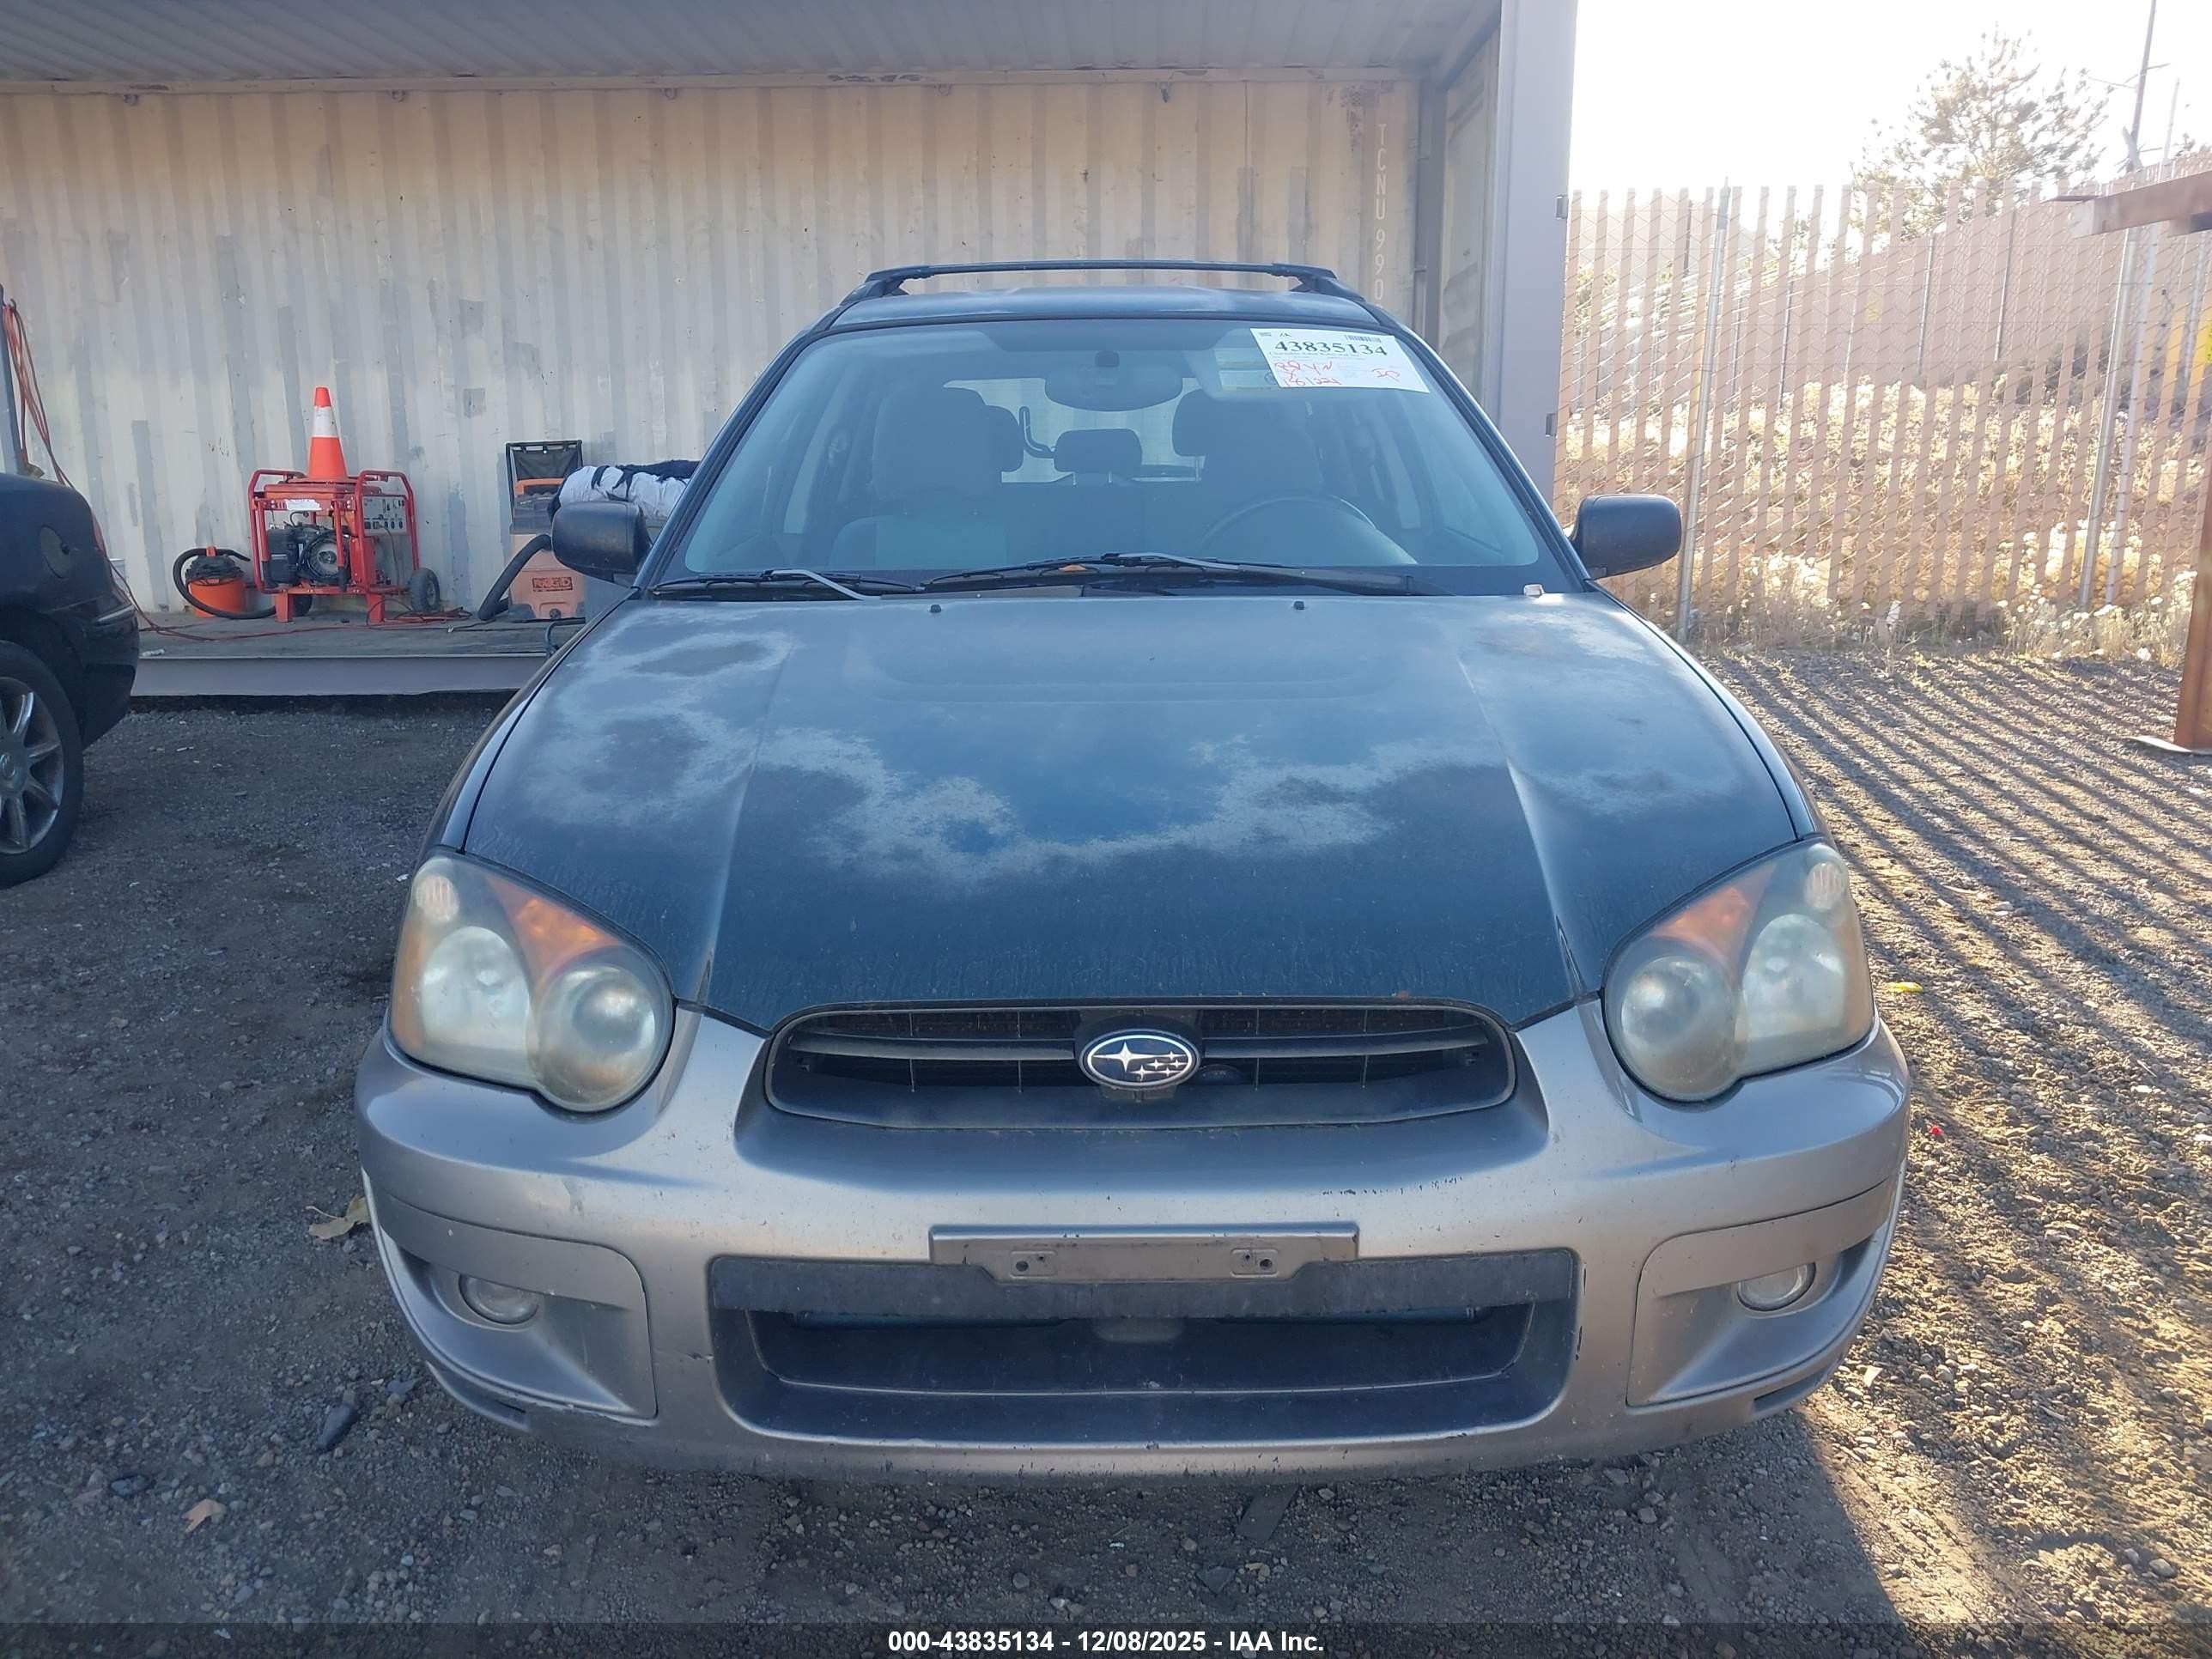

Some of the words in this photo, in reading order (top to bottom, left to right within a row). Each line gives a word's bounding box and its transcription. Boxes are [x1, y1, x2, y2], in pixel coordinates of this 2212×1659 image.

[1376, 124, 1388, 221] TCNU
[1374, 228, 1386, 308] 990
[1274, 340, 1389, 356] 43835134
